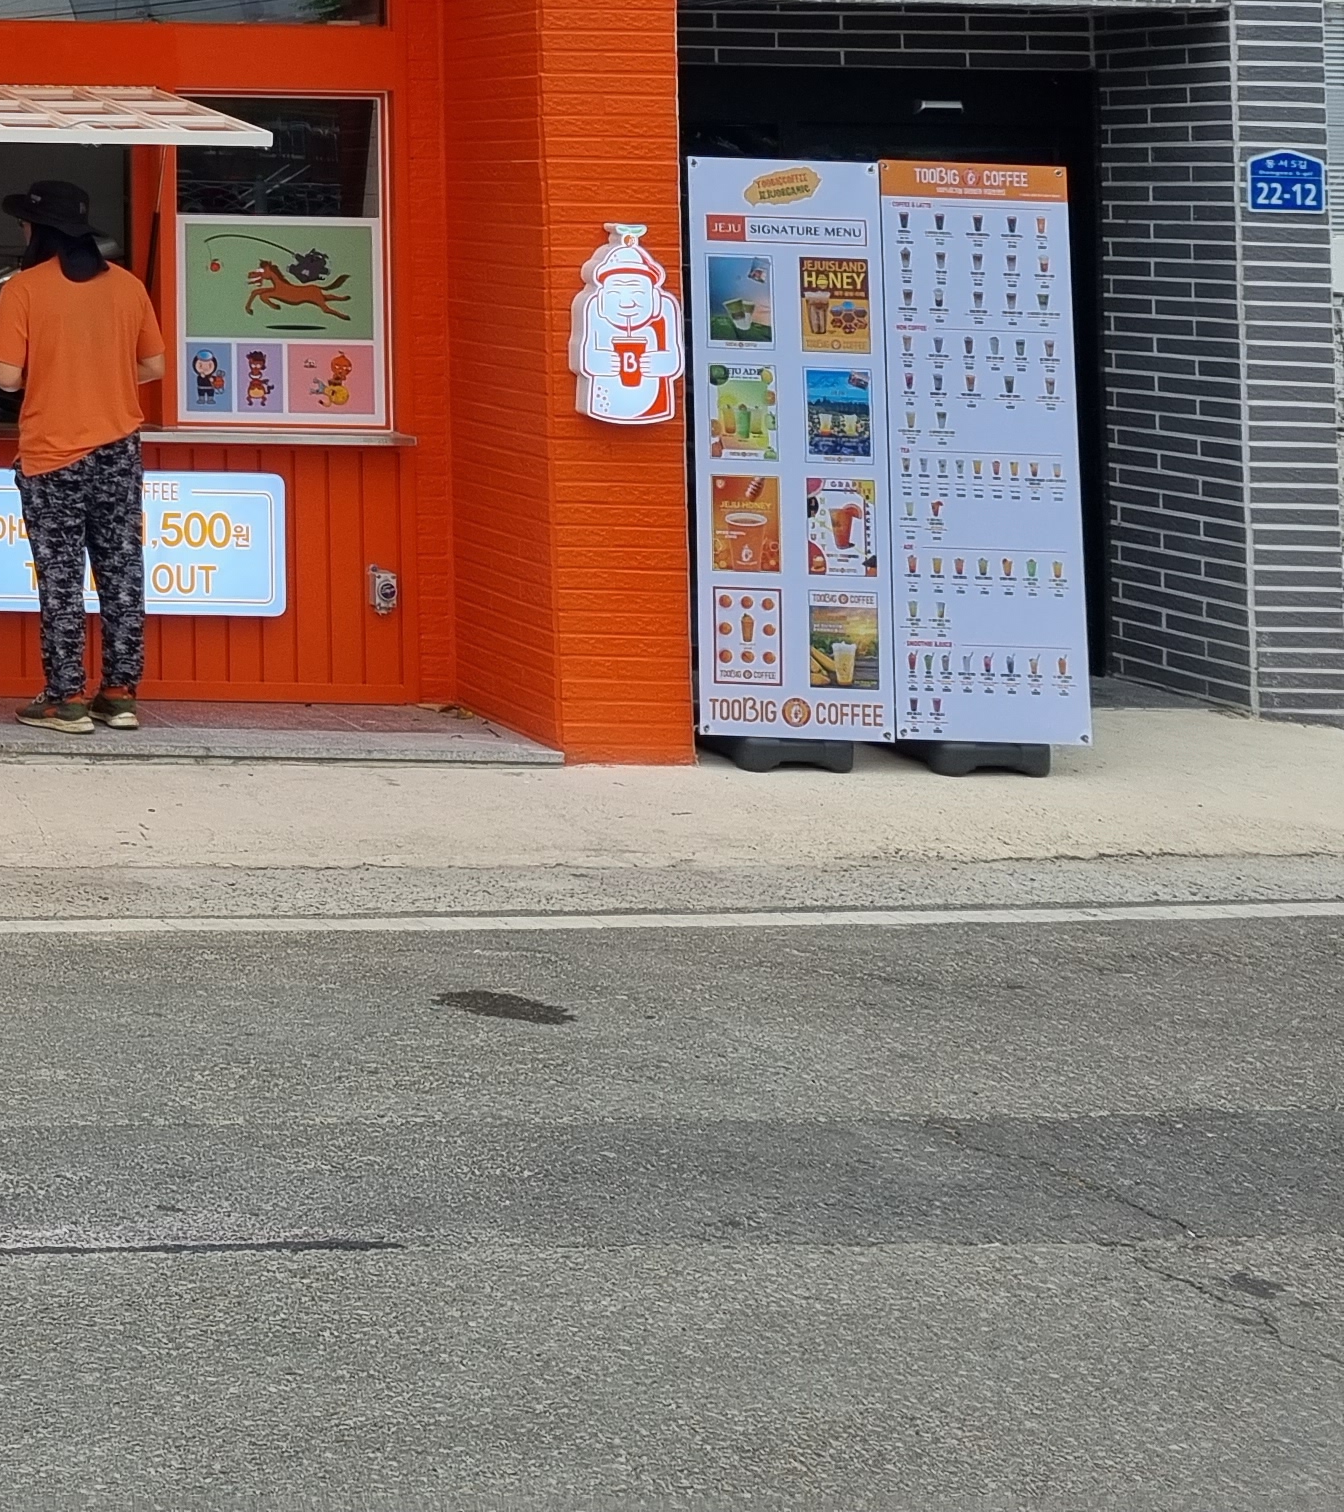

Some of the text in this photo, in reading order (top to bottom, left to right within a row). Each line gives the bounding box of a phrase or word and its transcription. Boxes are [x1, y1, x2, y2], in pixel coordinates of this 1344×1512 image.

[914, 167, 1029, 187] TOOBIG COFFEE
[1256, 181, 1318, 206] 22-12
[711, 221, 862, 238] JEJU SIGNATURE MENU
[802, 259, 866, 273] JEJUISLAND
[143, 482, 179, 501] FFEE
[151, 564, 217, 595] OUT
[709, 697, 884, 727] TOOBIG COFFEE
